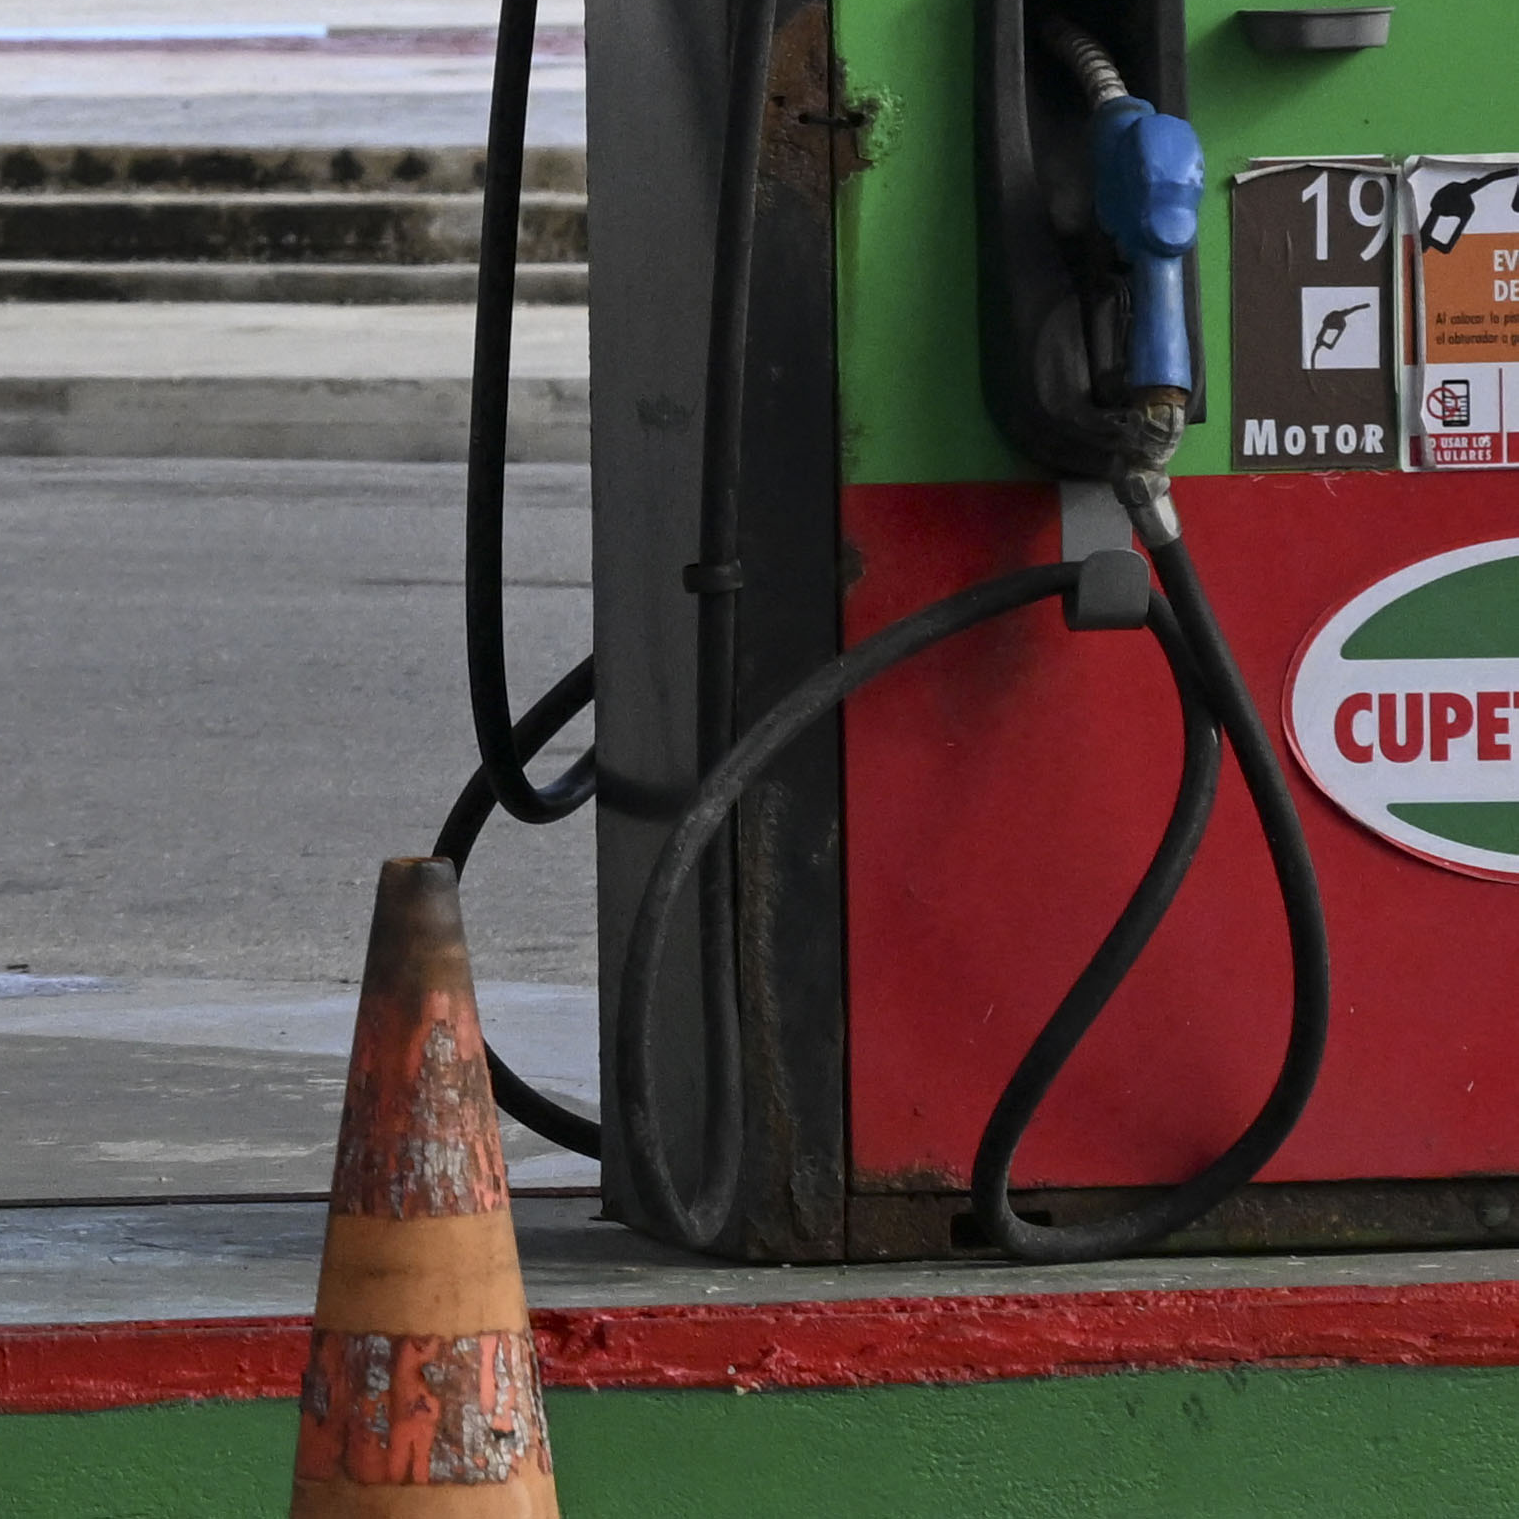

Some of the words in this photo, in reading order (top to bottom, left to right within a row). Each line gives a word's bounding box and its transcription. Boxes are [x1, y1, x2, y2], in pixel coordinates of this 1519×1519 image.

[1302, 171, 1389, 262] 19
[1243, 419, 1385, 456] MOTOR
[1440, 437, 1468, 449] USAR
[1333, 690, 1519, 764] CUPE
